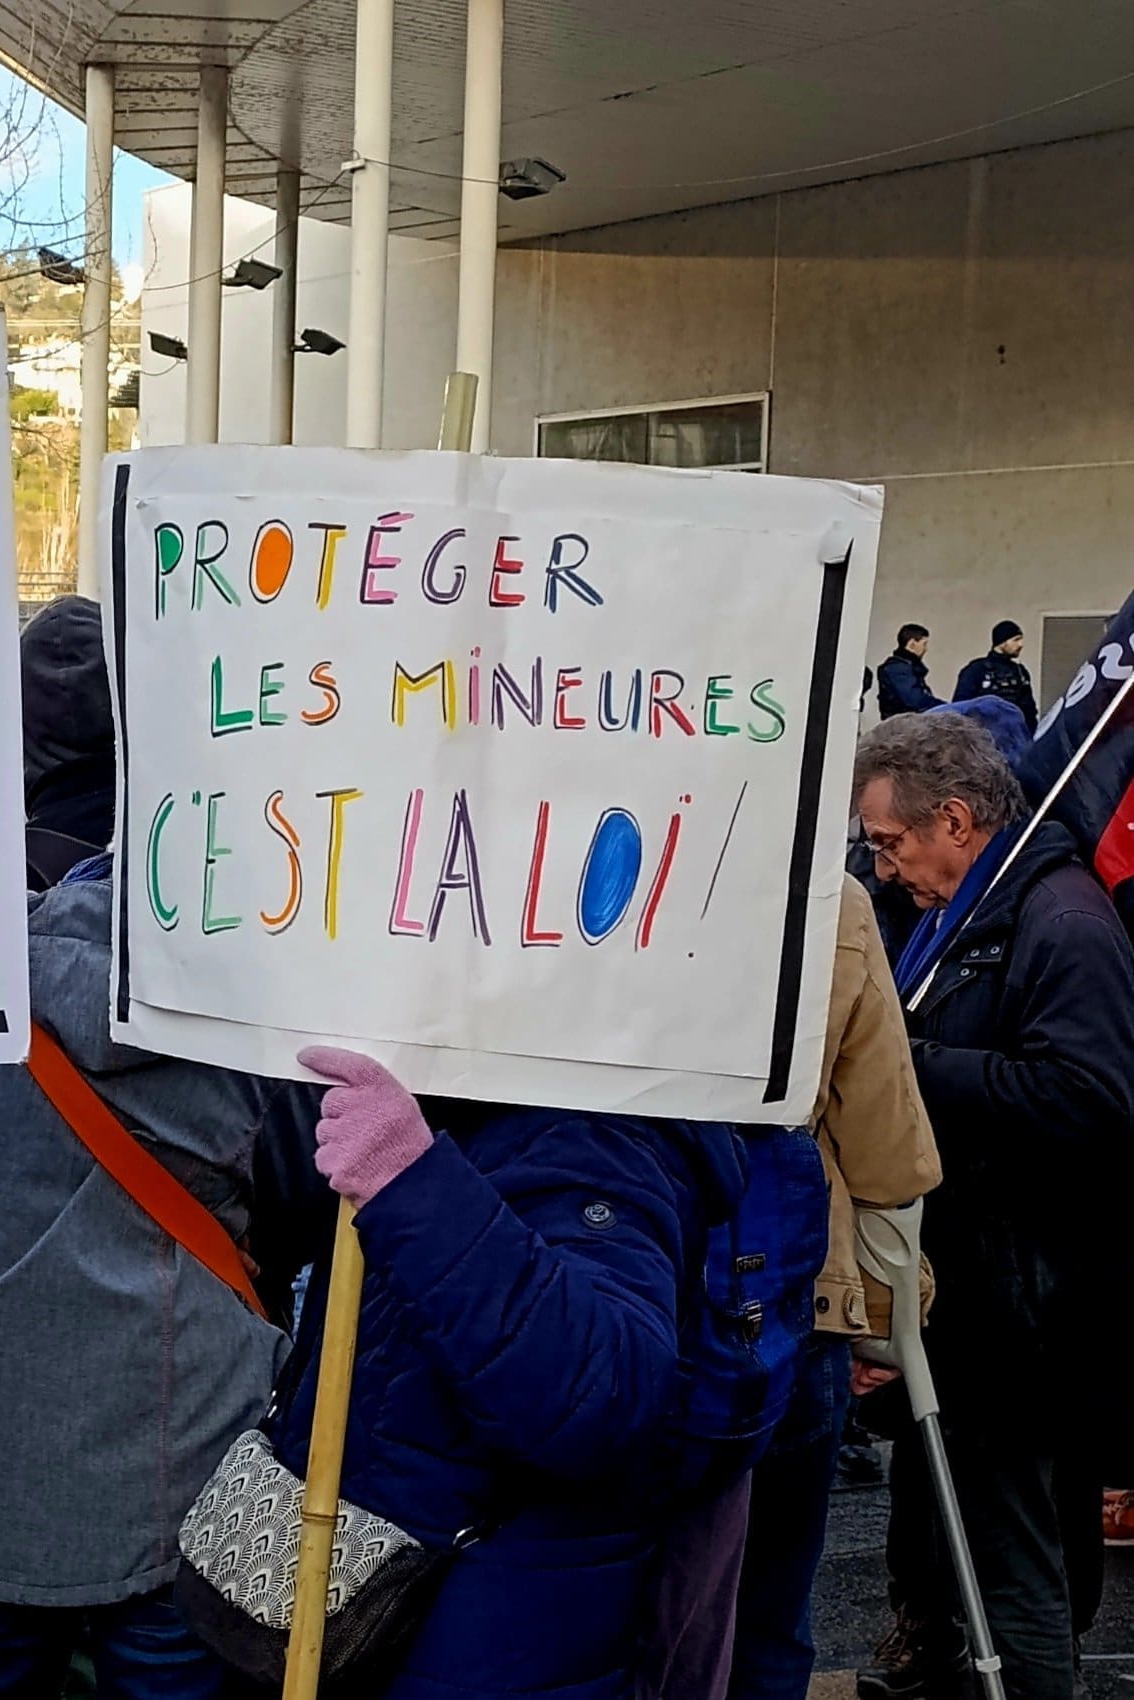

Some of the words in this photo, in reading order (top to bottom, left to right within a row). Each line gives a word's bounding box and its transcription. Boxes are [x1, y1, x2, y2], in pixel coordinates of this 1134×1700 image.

[154, 512, 604, 621] PROTÉGER
[211, 655, 340, 738] LES
[146, 788, 364, 941] C'EST
[388, 789, 491, 946] LA
